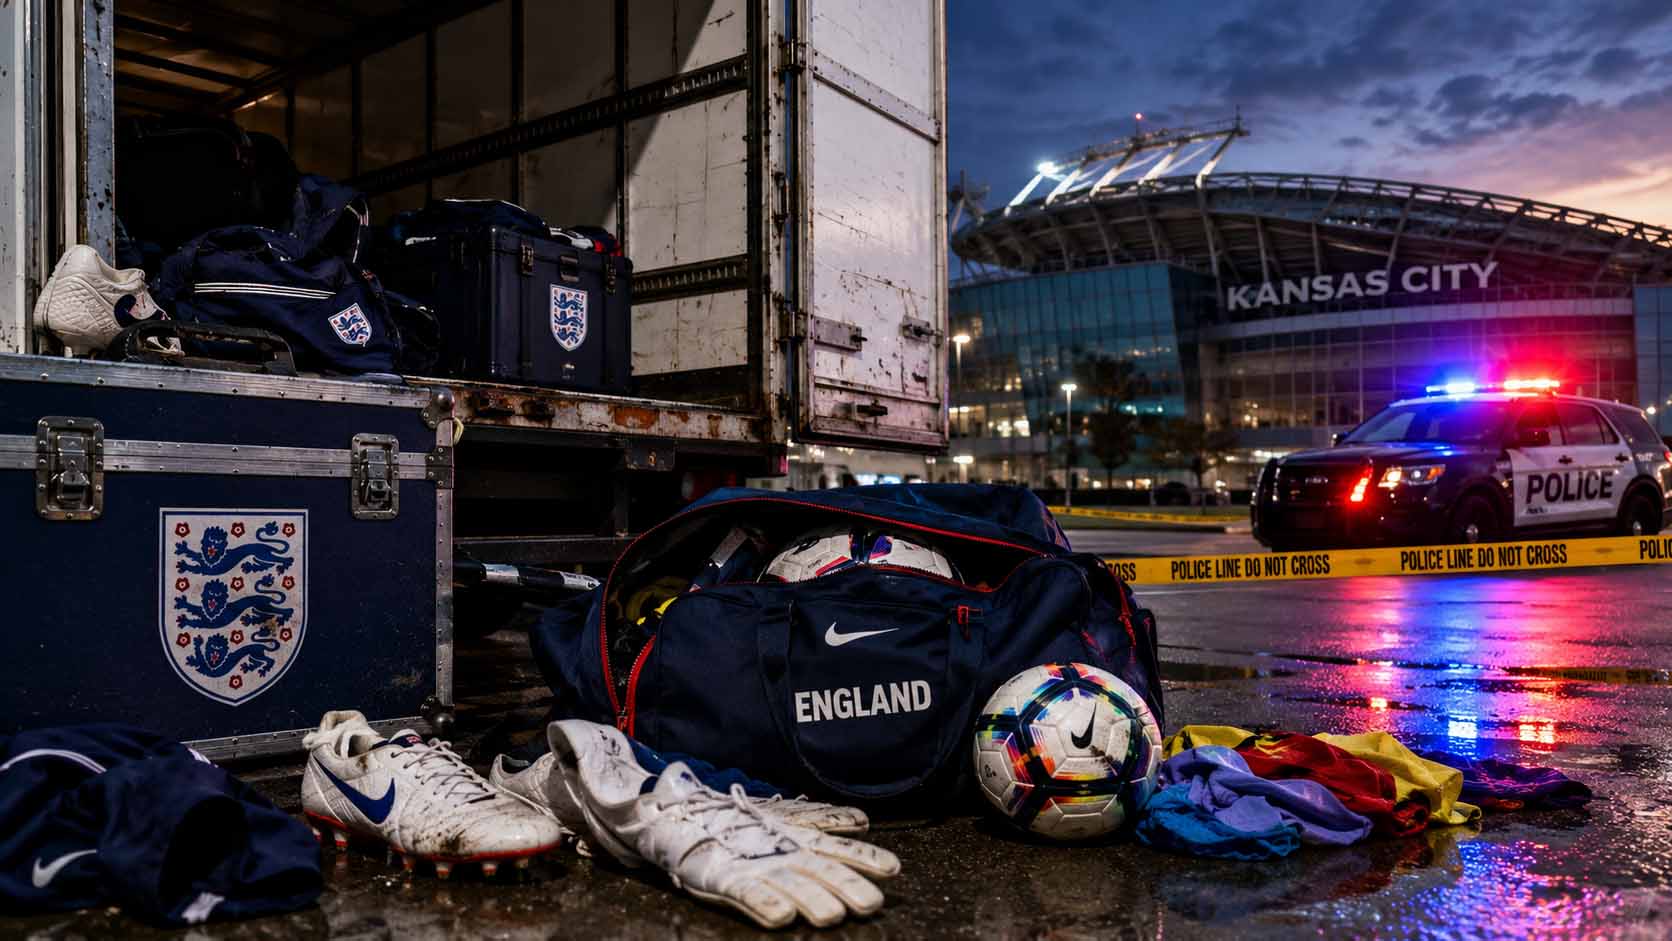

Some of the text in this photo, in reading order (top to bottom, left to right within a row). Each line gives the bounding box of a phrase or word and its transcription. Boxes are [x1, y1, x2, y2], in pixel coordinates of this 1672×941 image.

[1227, 262, 1498, 311] KANSAS CITY
[1525, 470, 1613, 504] POLICE
[1171, 554, 1330, 580] POLICE LINE DO NOT CROSS
[1401, 543, 1568, 571] POLICE LINE DO NOT CROSS
[794, 680, 932, 723] ENGLAND
